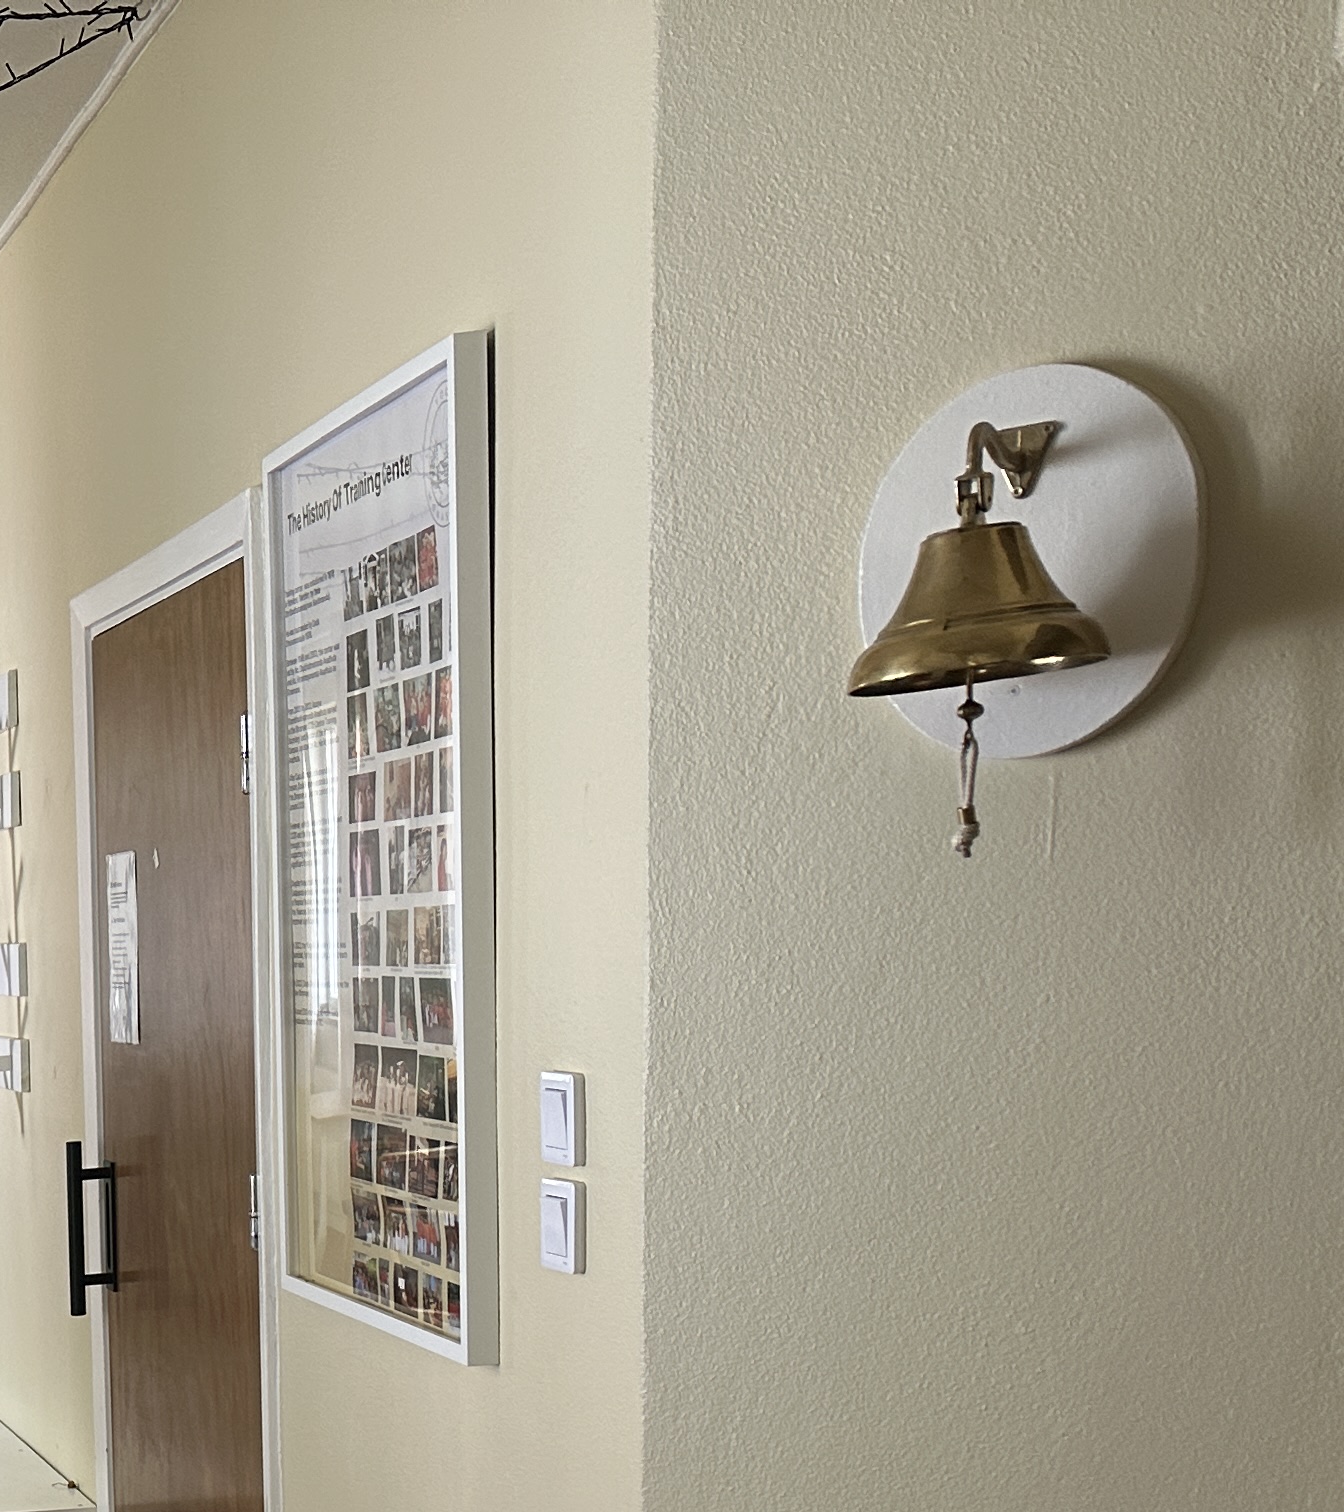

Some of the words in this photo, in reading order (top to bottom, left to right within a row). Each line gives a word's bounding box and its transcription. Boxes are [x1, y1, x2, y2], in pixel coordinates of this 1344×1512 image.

[287, 512, 302, 535] The
[302, 499, 331, 528] History
[332, 486, 342, 511] Of
[344, 471, 381, 505] Training
[382, 454, 413, 486] Center
